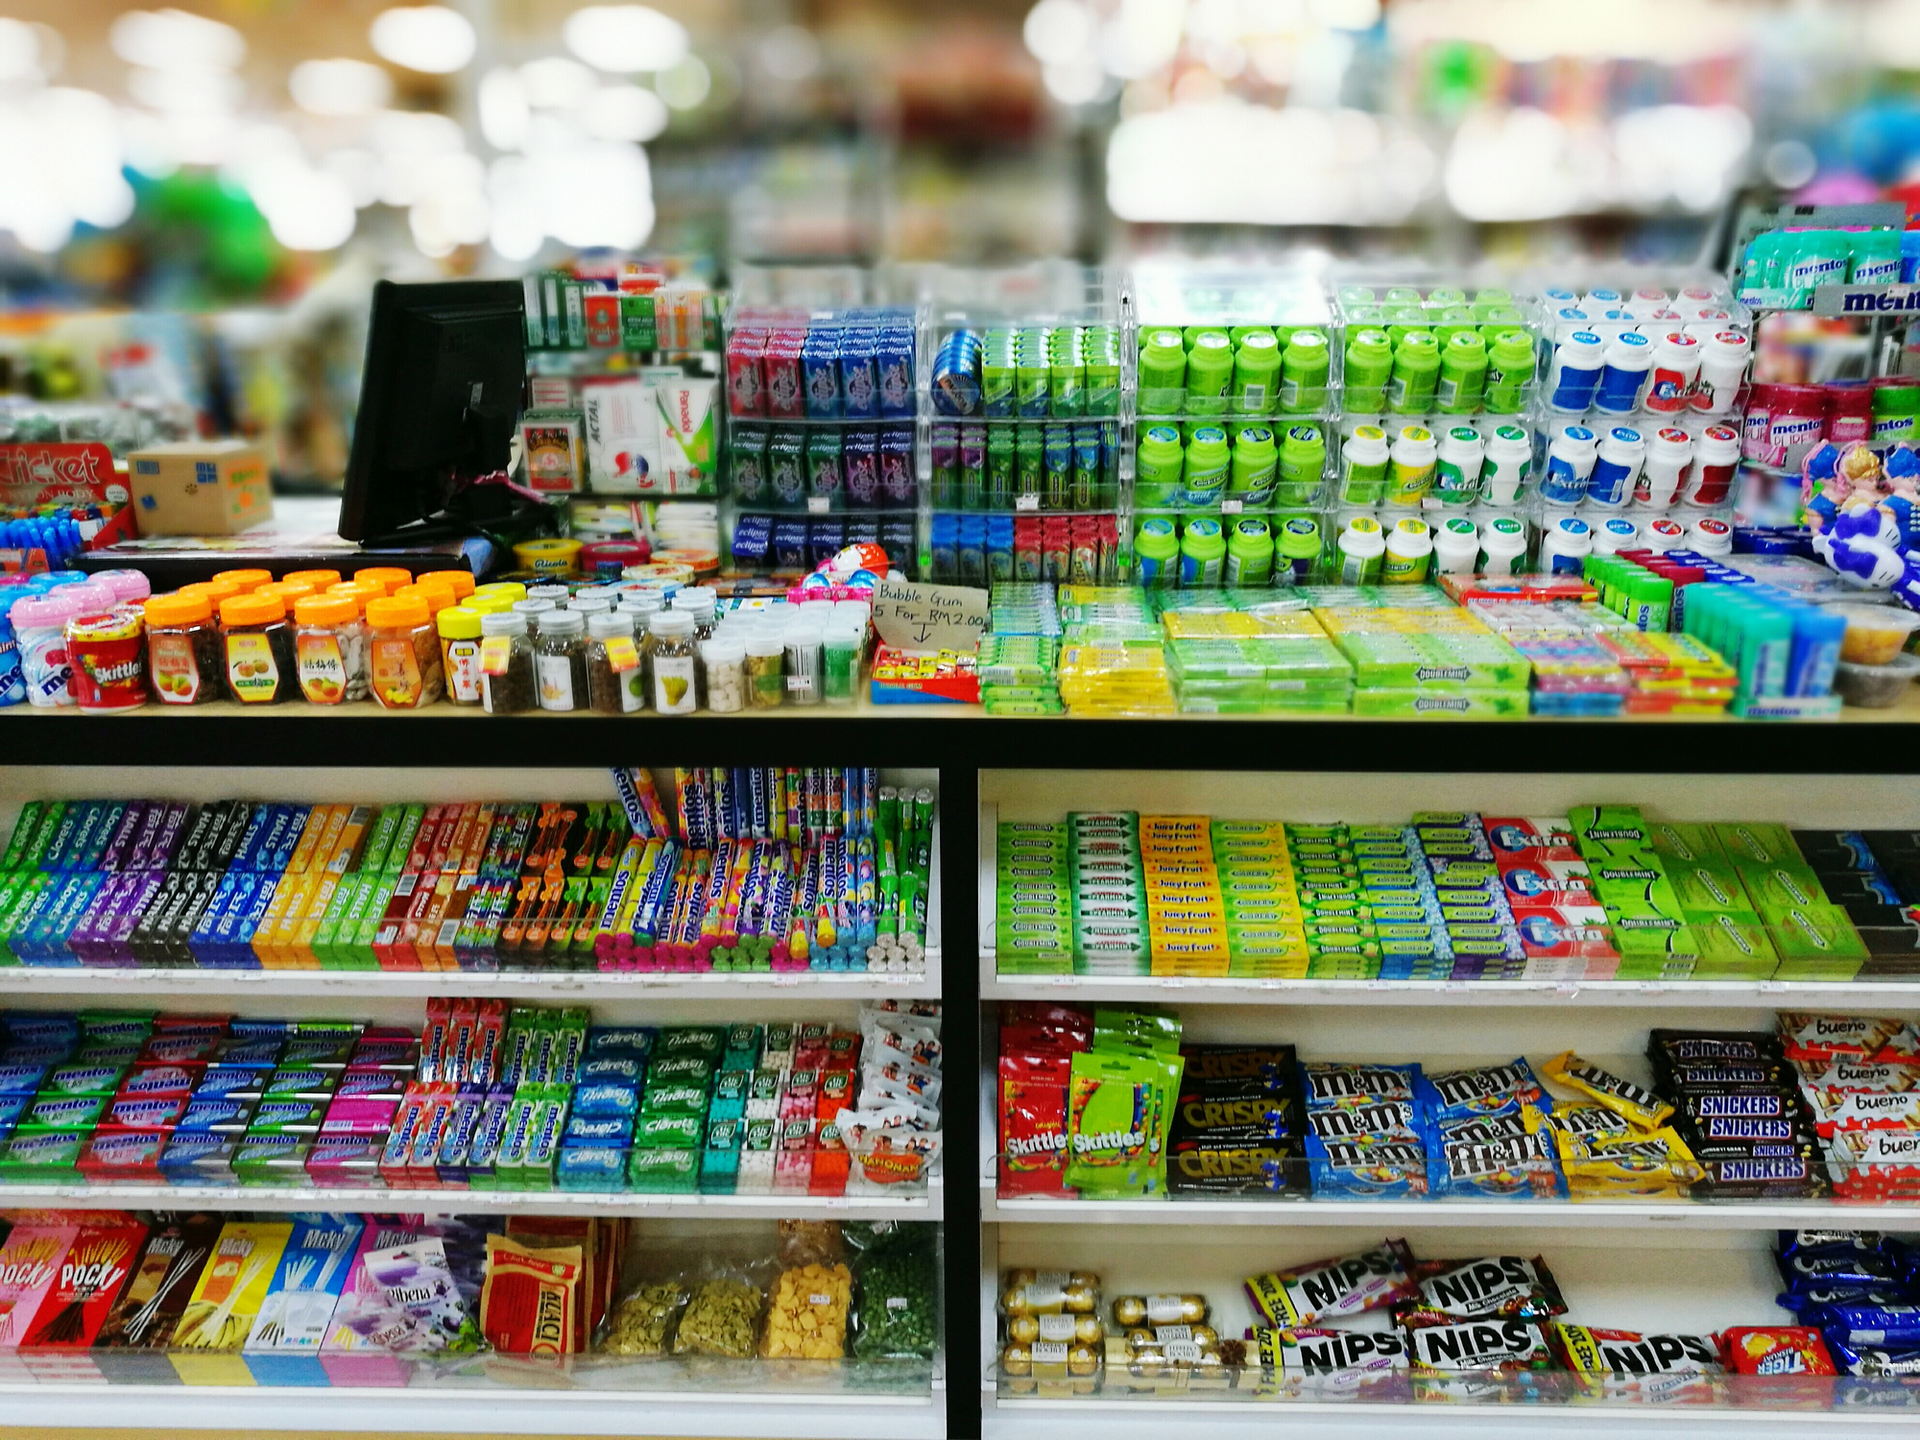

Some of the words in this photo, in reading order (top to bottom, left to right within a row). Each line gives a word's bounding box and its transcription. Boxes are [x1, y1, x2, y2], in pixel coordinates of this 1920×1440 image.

[679, 390, 694, 434] Panadol
[743, 515, 772, 525] eclipse
[738, 527, 768, 538] eclipse
[735, 540, 766, 550] eclipse
[534, 558, 569, 568] Ricola
[880, 583, 922, 604] Bubble
[930, 590, 963, 607] Gum
[873, 605, 885, 617] 5
[895, 605, 920, 621] For
[1419, 668, 1467, 681] DOUBLEMINT
[1418, 699, 1467, 711] DOUBLEMINT
[115, 810, 140, 848] HALLS
[189, 811, 212, 848] HALLS
[265, 813, 289, 850] HALLS
[399, 814, 420, 850] HALLS
[1501, 830, 1569, 847] Extra
[235, 824, 260, 860] HALLS
[824, 840, 837, 898] mentos
[1181, 865, 1203, 874] Fruit
[1603, 869, 1656, 880] DOUBLEMINT
[1158, 881, 1181, 889] Juicy
[1183, 880, 1206, 889] Fruit
[1515, 873, 1587, 892] Extra
[132, 879, 161, 918] HALLS
[350, 883, 372, 920] HALLS
[599, 870, 631, 930] mentos
[1161, 895, 1184, 904] Juicy
[1186, 895, 1209, 904] Fruit
[139, 891, 168, 932] HALLS
[158, 891, 187, 932] HALLS
[178, 891, 206, 932] HALLS
[280, 892, 304, 931] HALLS
[1162, 910, 1185, 920] Juicy
[1188, 910, 1211, 919] Fruit
[1315, 908, 1355, 917] DOUBLEMINT
[1164, 926, 1187, 935] Juicy
[1189, 925, 1213, 935] Fruit
[1318, 926, 1358, 934] DOUBLEMINT
[1531, 921, 1604, 942] Extra
[1621, 918, 1676, 929] DOUBLEMINT
[1165, 943, 1188, 952] Juicy
[1191, 942, 1215, 951] Fruit
[1321, 945, 1360, 954] DOUBLEMINT
[1816, 1019, 1866, 1035] bueno
[597, 1032, 643, 1045] Clorets
[54, 1067, 119, 1082] mentos
[587, 1059, 634, 1073] Clorets
[1837, 1064, 1890, 1080] bueno
[275, 1071, 327, 1081] mentos
[33, 1099, 100, 1115] mentos
[112, 1101, 181, 1115] mentos
[188, 1102, 241, 1113] mentos
[260, 1103, 313, 1113] mentos
[1702, 1096, 1779, 1115] SNICKERS
[1855, 1095, 1908, 1109] bueno
[1183, 1099, 1291, 1129] CRISPY
[395, 1107, 420, 1158] mentos
[423, 1107, 447, 1157] mentos
[453, 1106, 477, 1156] mentos
[482, 1107, 504, 1157] mentos
[511, 1106, 532, 1157] mentos
[537, 1107, 559, 1157] mentos
[573, 1121, 622, 1134] Clorets
[646, 1118, 694, 1132] Clorets
[1711, 1118, 1790, 1138] SNICKERS
[172, 1133, 226, 1144] mentos
[245, 1135, 299, 1145] mentos
[318, 1136, 371, 1145] mentos
[1073, 1130, 1145, 1153] Skittles
[1753, 1146, 1794, 1156] SNICKERS
[1178, 1147, 1290, 1178] CRISPY
[1722, 1160, 1805, 1180] SNICKERS
[61, 1259, 126, 1291] POCKY
[1301, 1251, 1393, 1312] NIPS
[1431, 1256, 1530, 1308] NIPS
[1482, 1287, 1518, 1307] Chocolate
[1268, 1298, 1293, 1329] FREE
[1425, 1320, 1532, 1364] NIPS
[1301, 1332, 1403, 1377] NIPS
[1601, 1335, 1713, 1383] NIPS
[1757, 1350, 1806, 1377] TIGER
